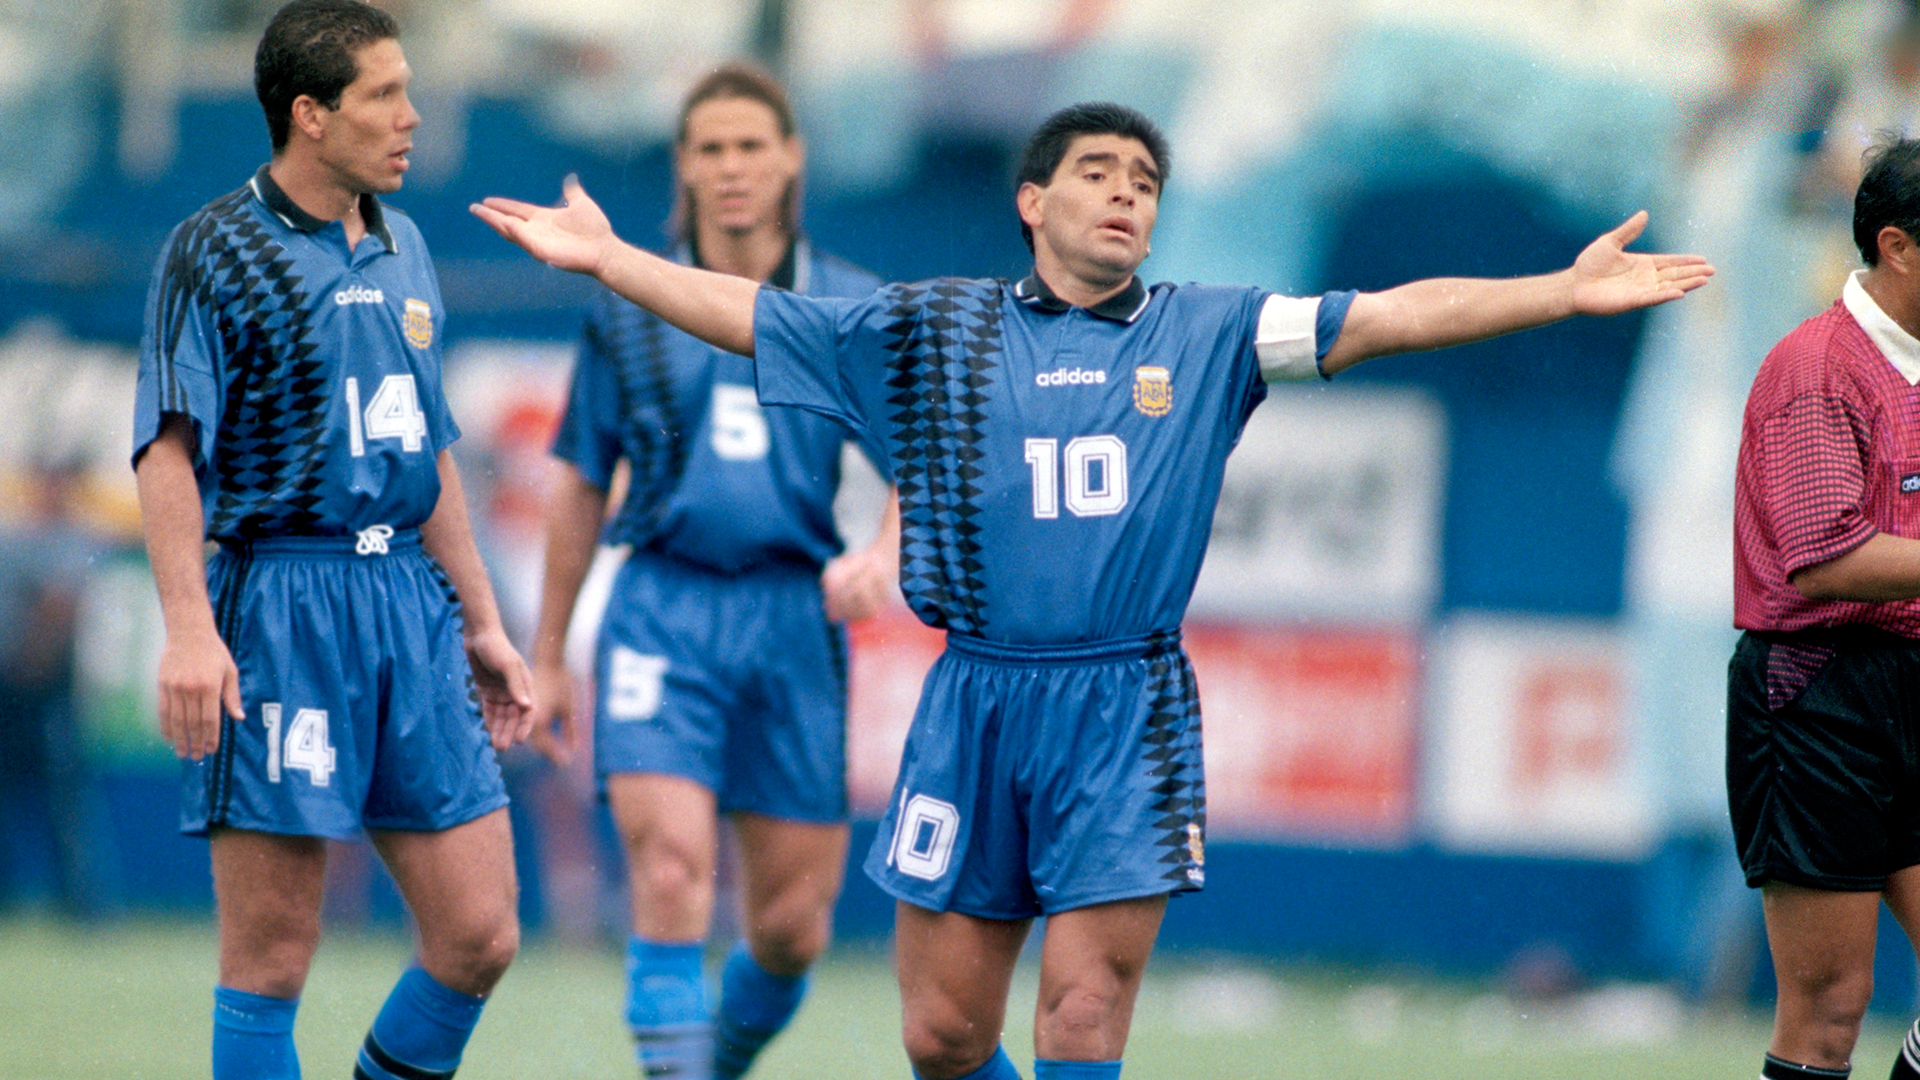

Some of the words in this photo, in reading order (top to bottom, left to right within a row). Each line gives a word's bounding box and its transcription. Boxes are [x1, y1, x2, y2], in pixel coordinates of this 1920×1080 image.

[346, 374, 425, 457] 14
[1036, 367, 1107, 387] adidas
[711, 383, 769, 461] 5
[1024, 435, 1129, 519] 10
[607, 646, 669, 722] 5
[262, 703, 335, 786] 14
